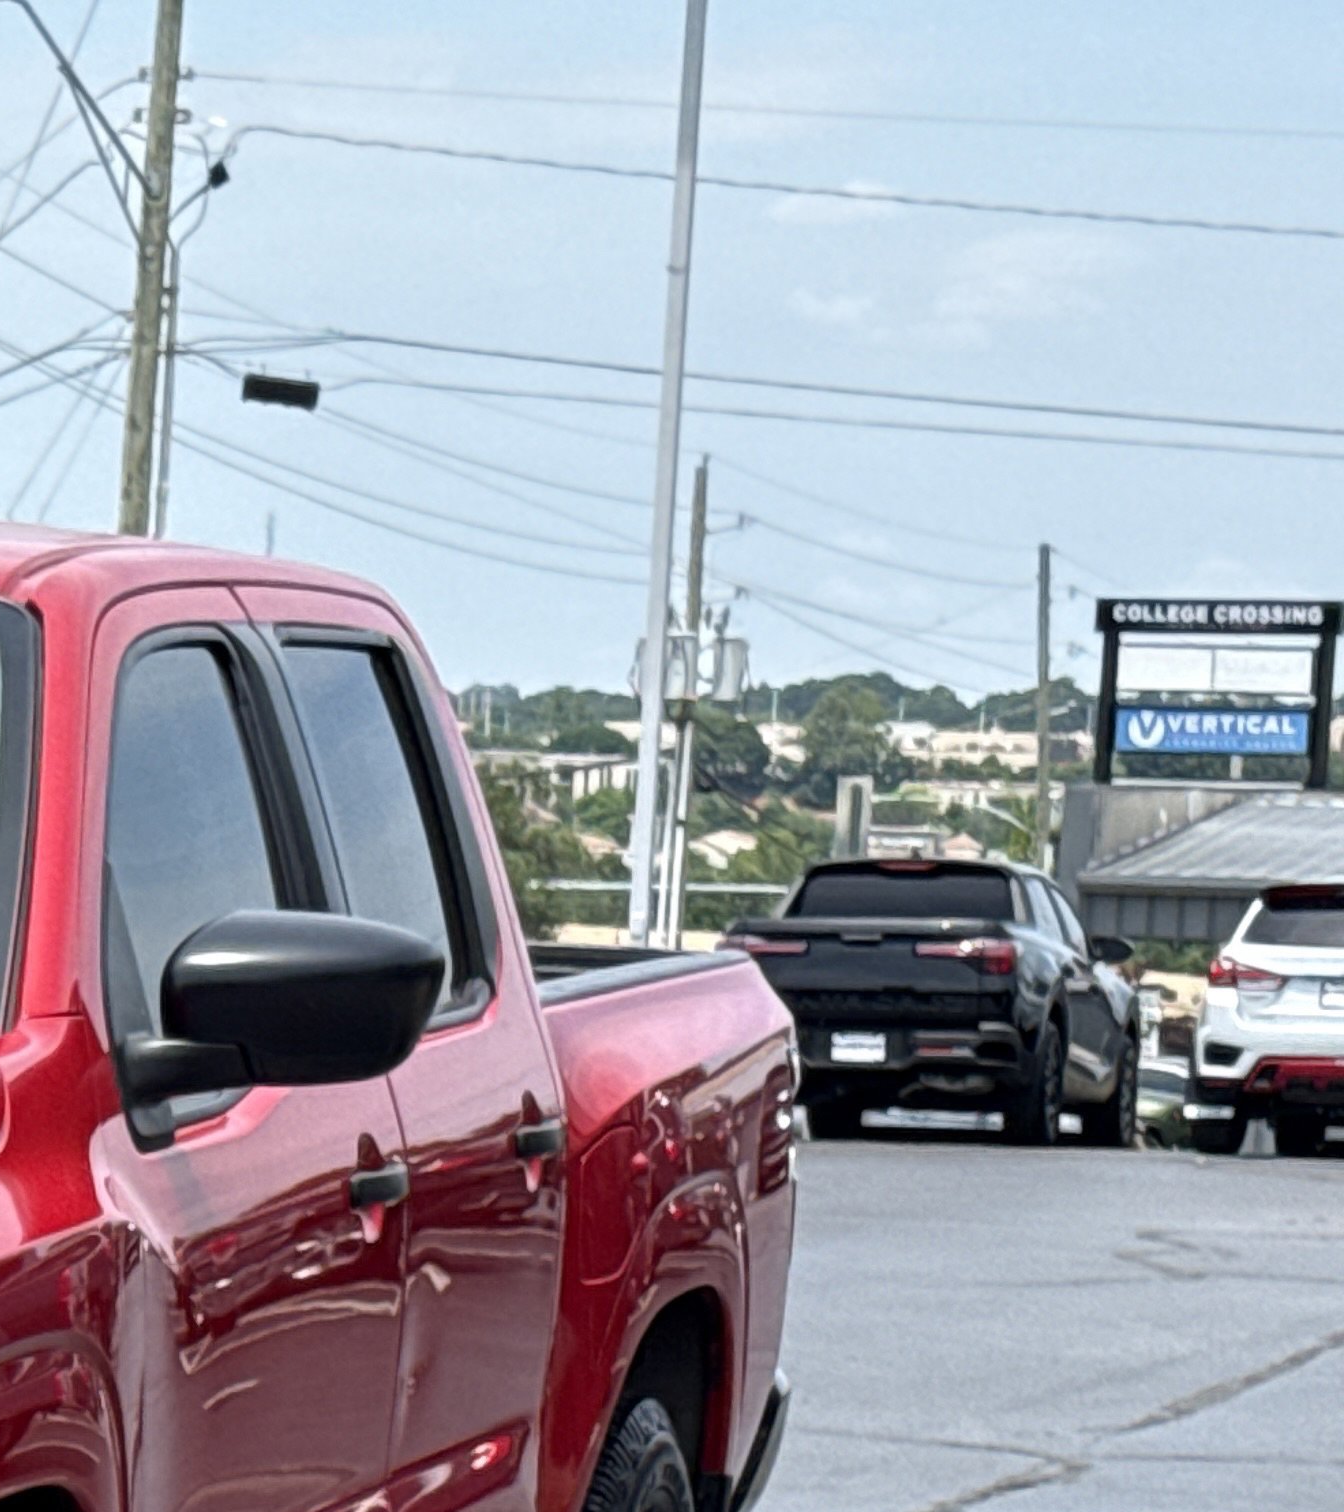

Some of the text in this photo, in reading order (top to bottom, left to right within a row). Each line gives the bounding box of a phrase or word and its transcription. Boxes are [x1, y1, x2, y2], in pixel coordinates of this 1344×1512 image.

[1113, 603, 1323, 626] COLLEGE CROSSING
[1167, 714, 1296, 735] VERTICAL
